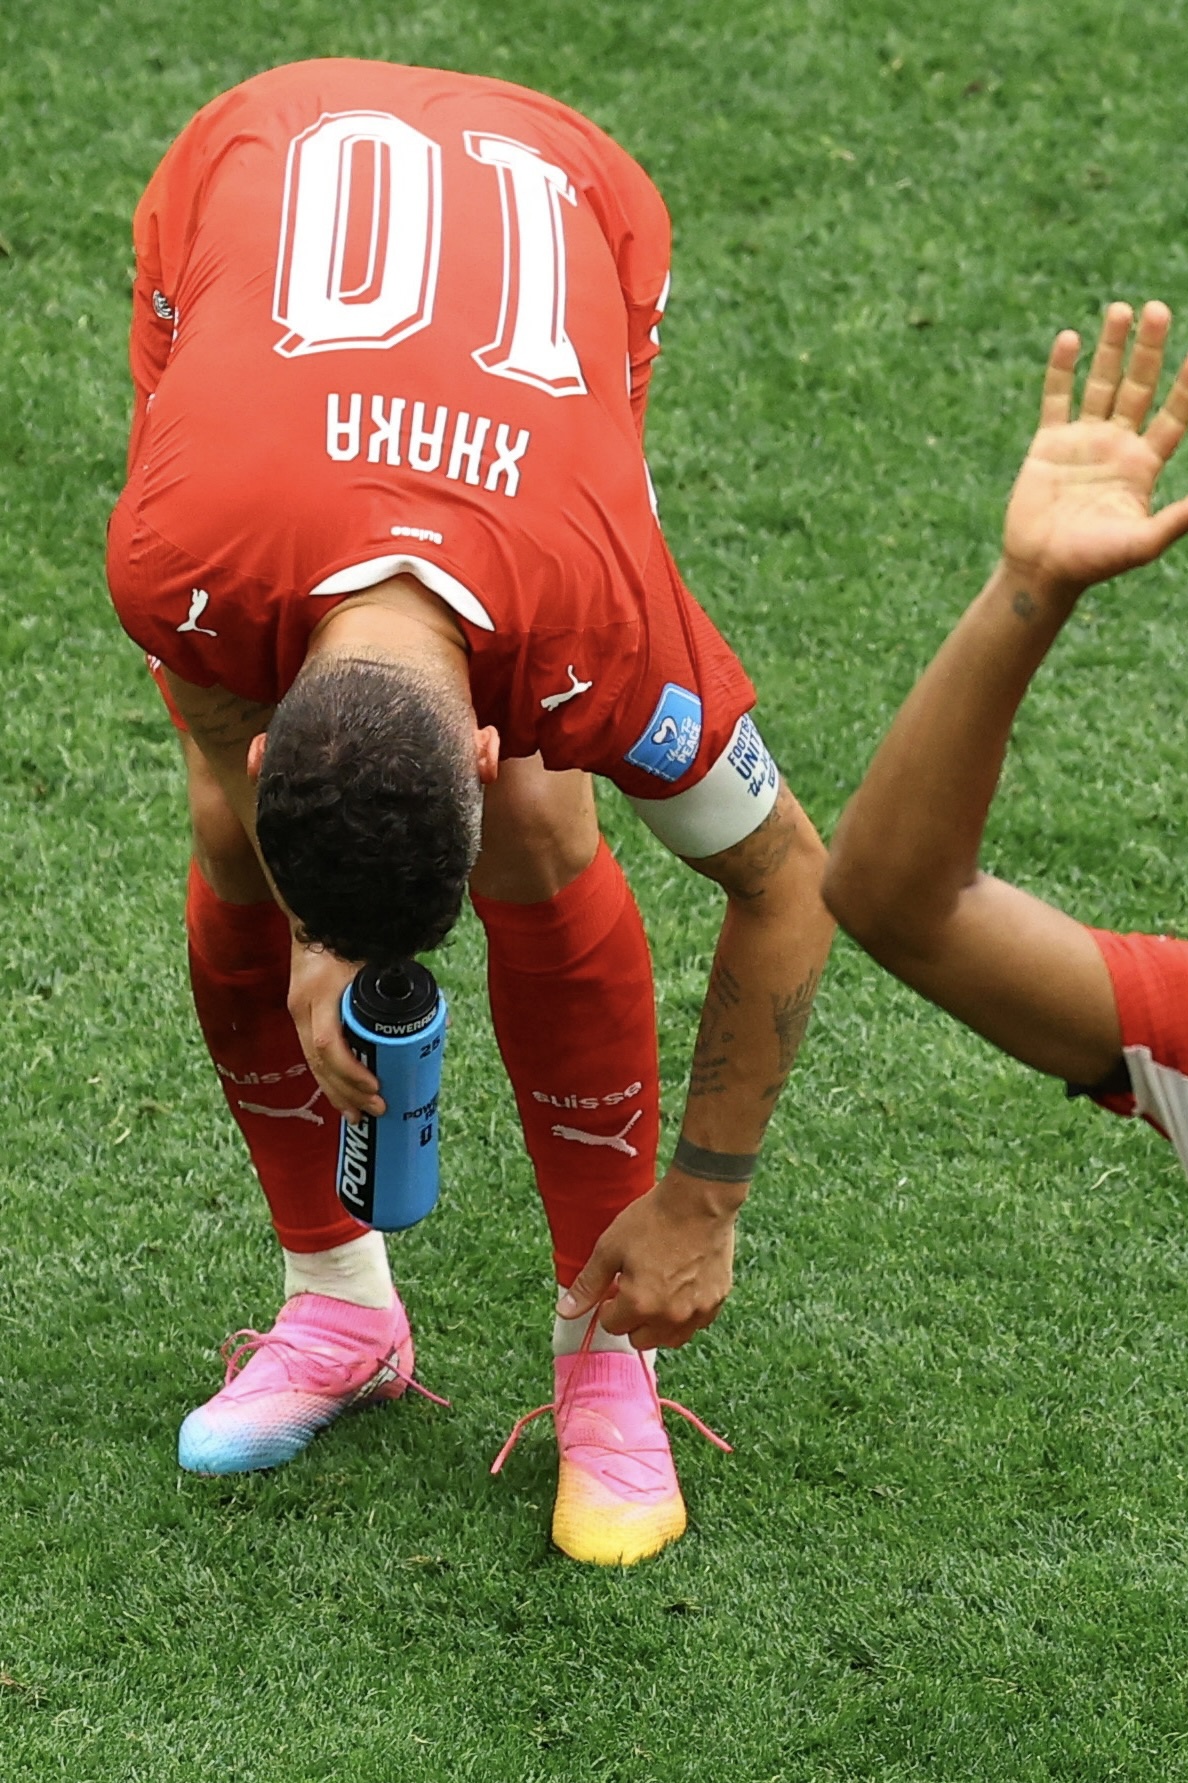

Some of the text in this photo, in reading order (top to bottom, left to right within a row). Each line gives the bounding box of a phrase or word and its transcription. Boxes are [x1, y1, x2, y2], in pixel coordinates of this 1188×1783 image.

[272, 110, 588, 397] 10
[326, 393, 530, 497] XHAKA
[735, 725, 761, 781] UNIT
[216, 1063, 307, 1085] suiss
[532, 1081, 642, 1110] suisse
